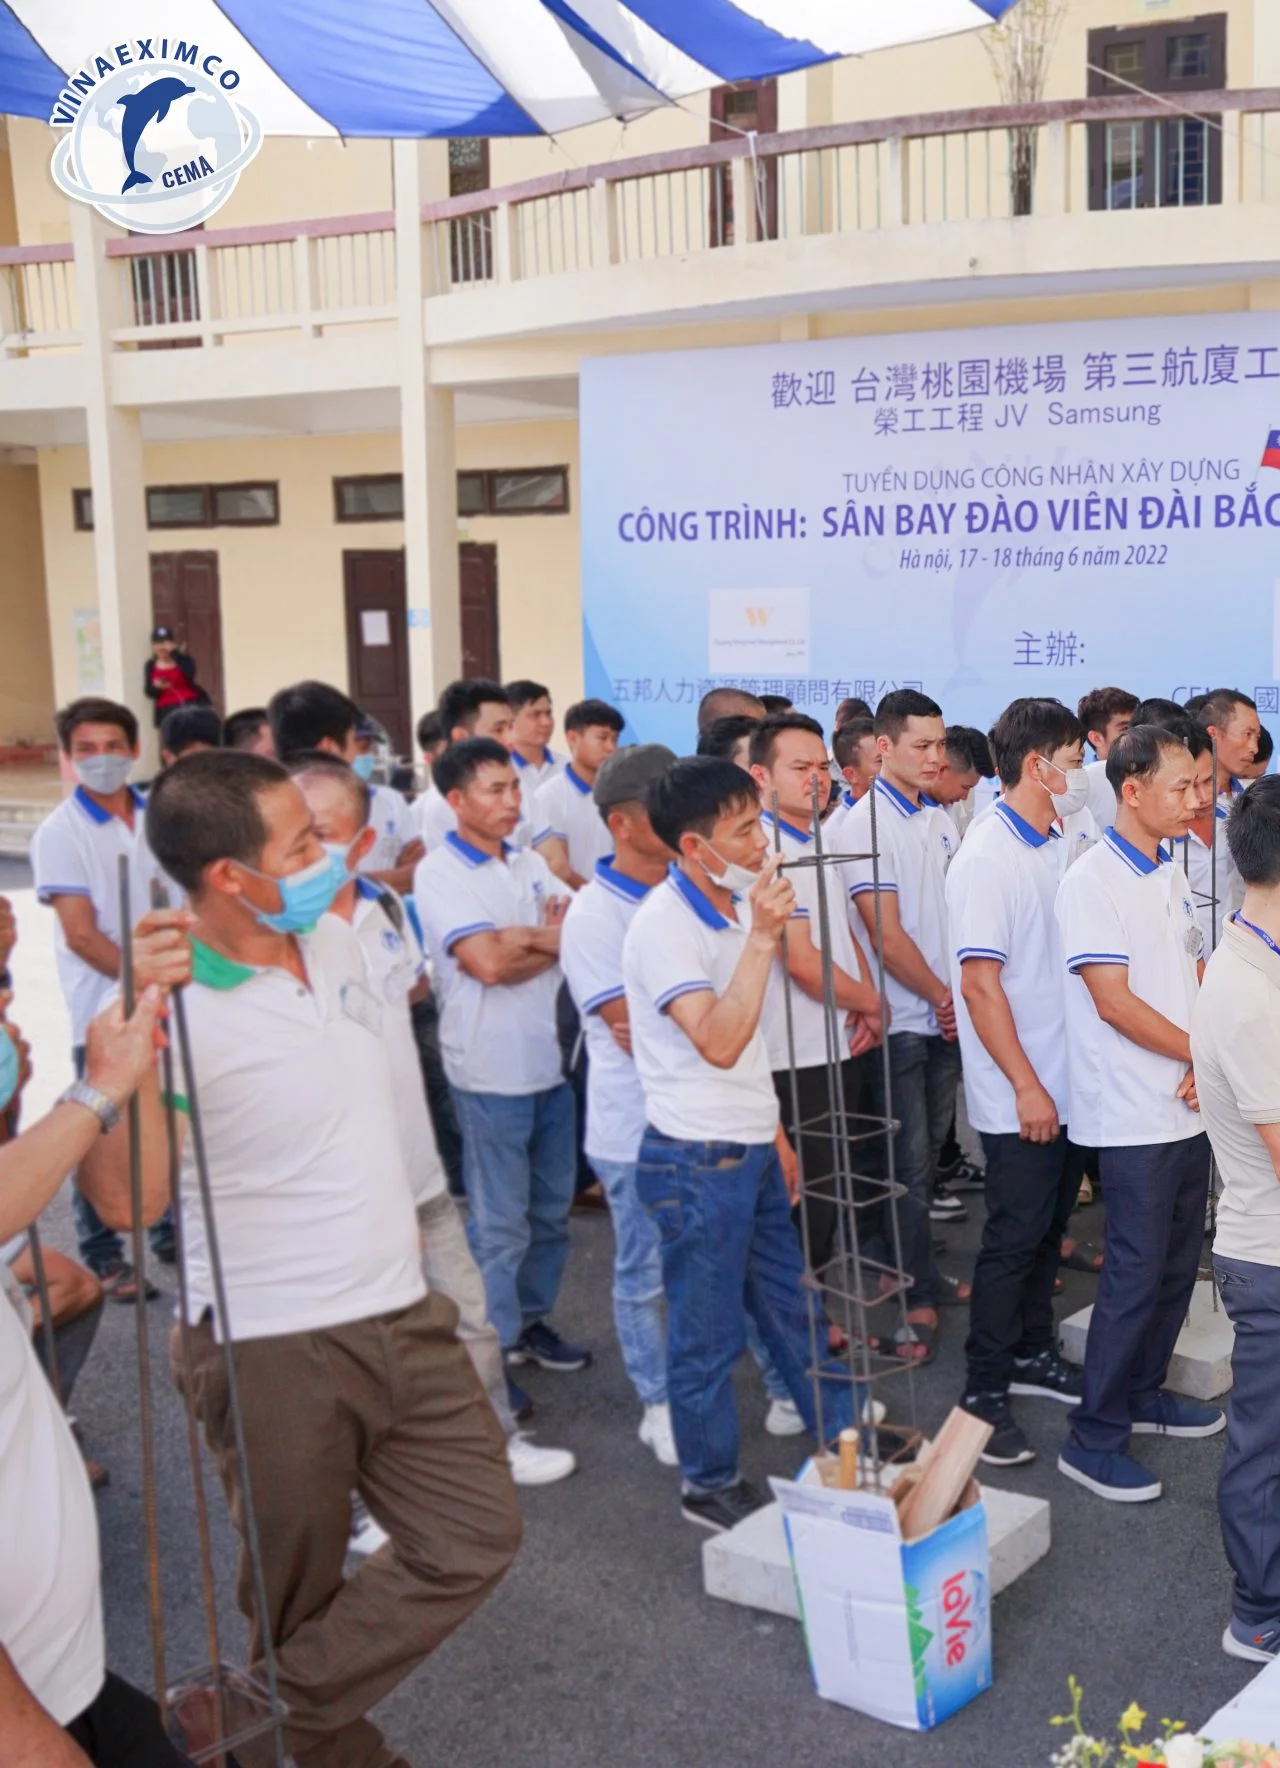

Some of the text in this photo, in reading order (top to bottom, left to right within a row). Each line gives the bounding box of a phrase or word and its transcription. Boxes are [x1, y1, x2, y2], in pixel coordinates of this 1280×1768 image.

[772, 370, 836, 409] 歡迎
[851, 354, 1067, 402] 台灣桃園機場
[874, 401, 1162, 437] 榮工工程 JV Samsung
[842, 457, 1241, 495] TUYỂN DỤNG CÔNG NHÂN XÂY DỰNG
[617, 506, 699, 543] CÔNG
[705, 502, 808, 540] TRÌNH:
[822, 500, 885, 538] SÂN
[895, 502, 956, 537] BAY
[965, 494, 1039, 534] ĐÀO
[1048, 490, 1128, 532] VIÊN
[1138, 488, 1201, 530] ĐÀI
[900, 548, 920, 569] Hà
[960, 548, 978, 569] 17
[994, 547, 1013, 568] 18
[1015, 546, 1063, 572] tháng
[1068, 546, 1079, 567] 6
[1082, 545, 1120, 567] năm
[1124, 544, 1168, 566] 2022
[942, 1569, 973, 1668] laVie
